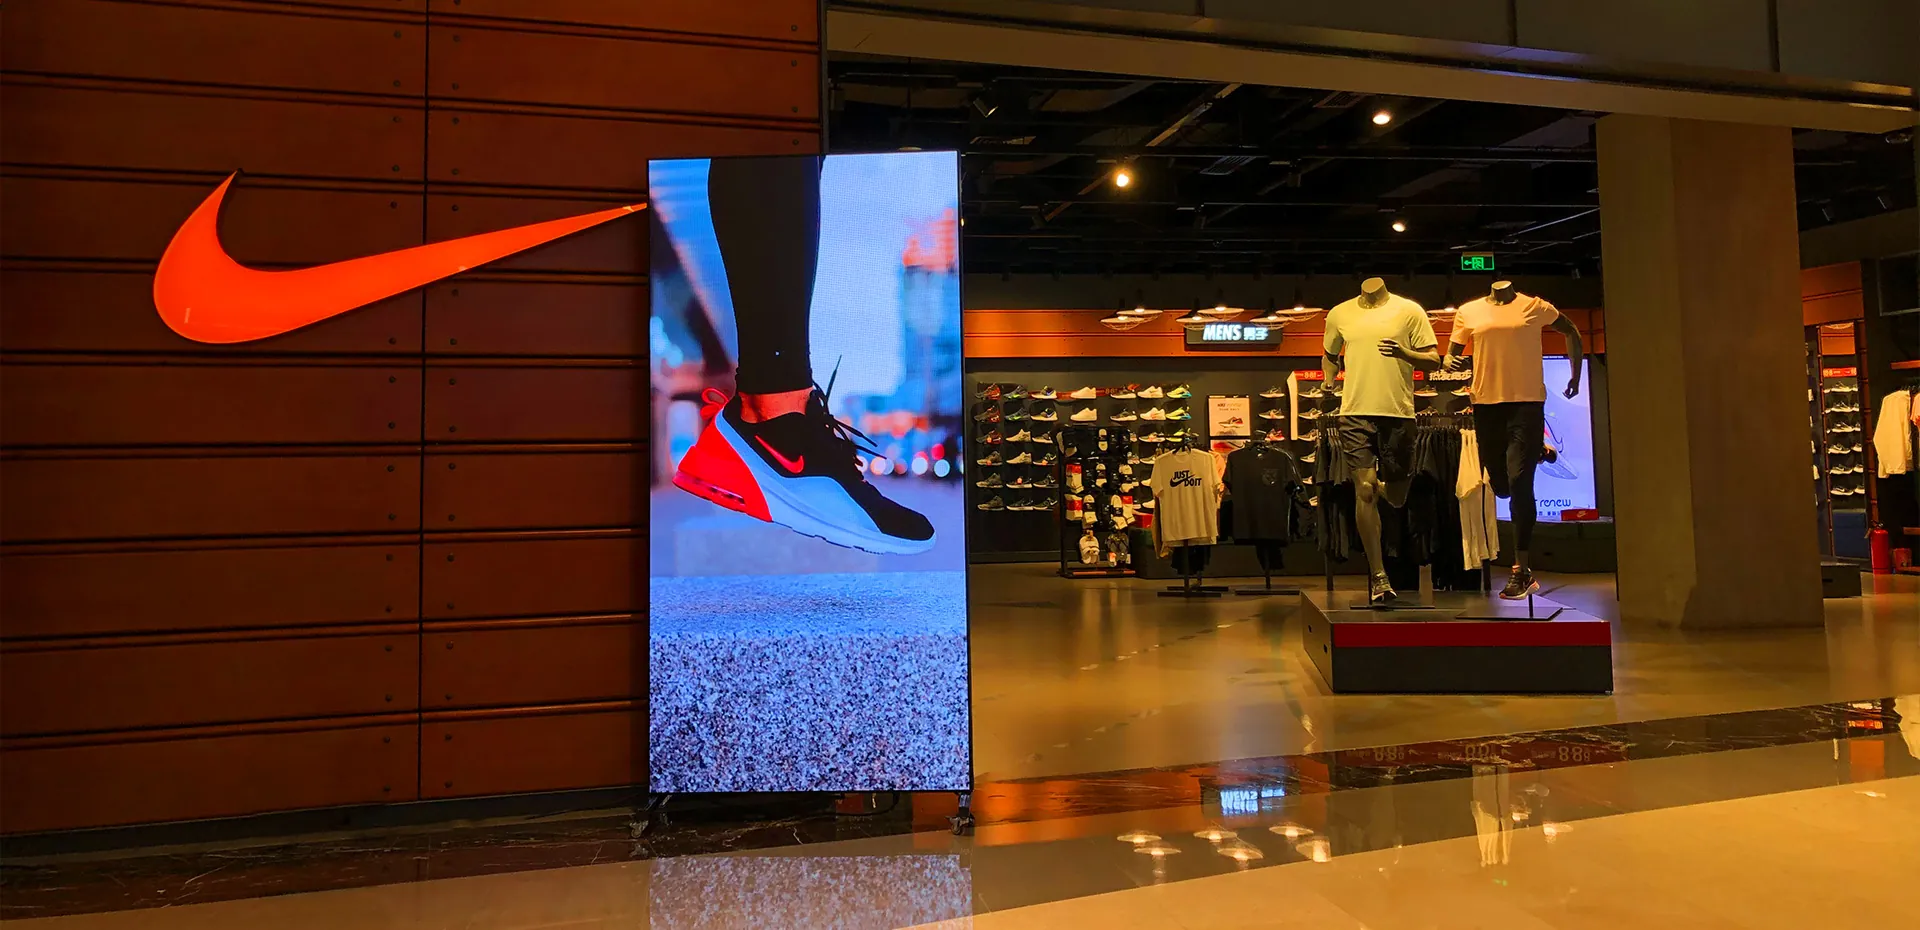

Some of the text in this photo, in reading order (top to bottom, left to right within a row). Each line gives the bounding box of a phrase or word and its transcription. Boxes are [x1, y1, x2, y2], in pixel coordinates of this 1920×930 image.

[1243, 327, 1268, 341] 男子
[1173, 470, 1190, 480] JUST
[1540, 499, 1571, 508] renew
